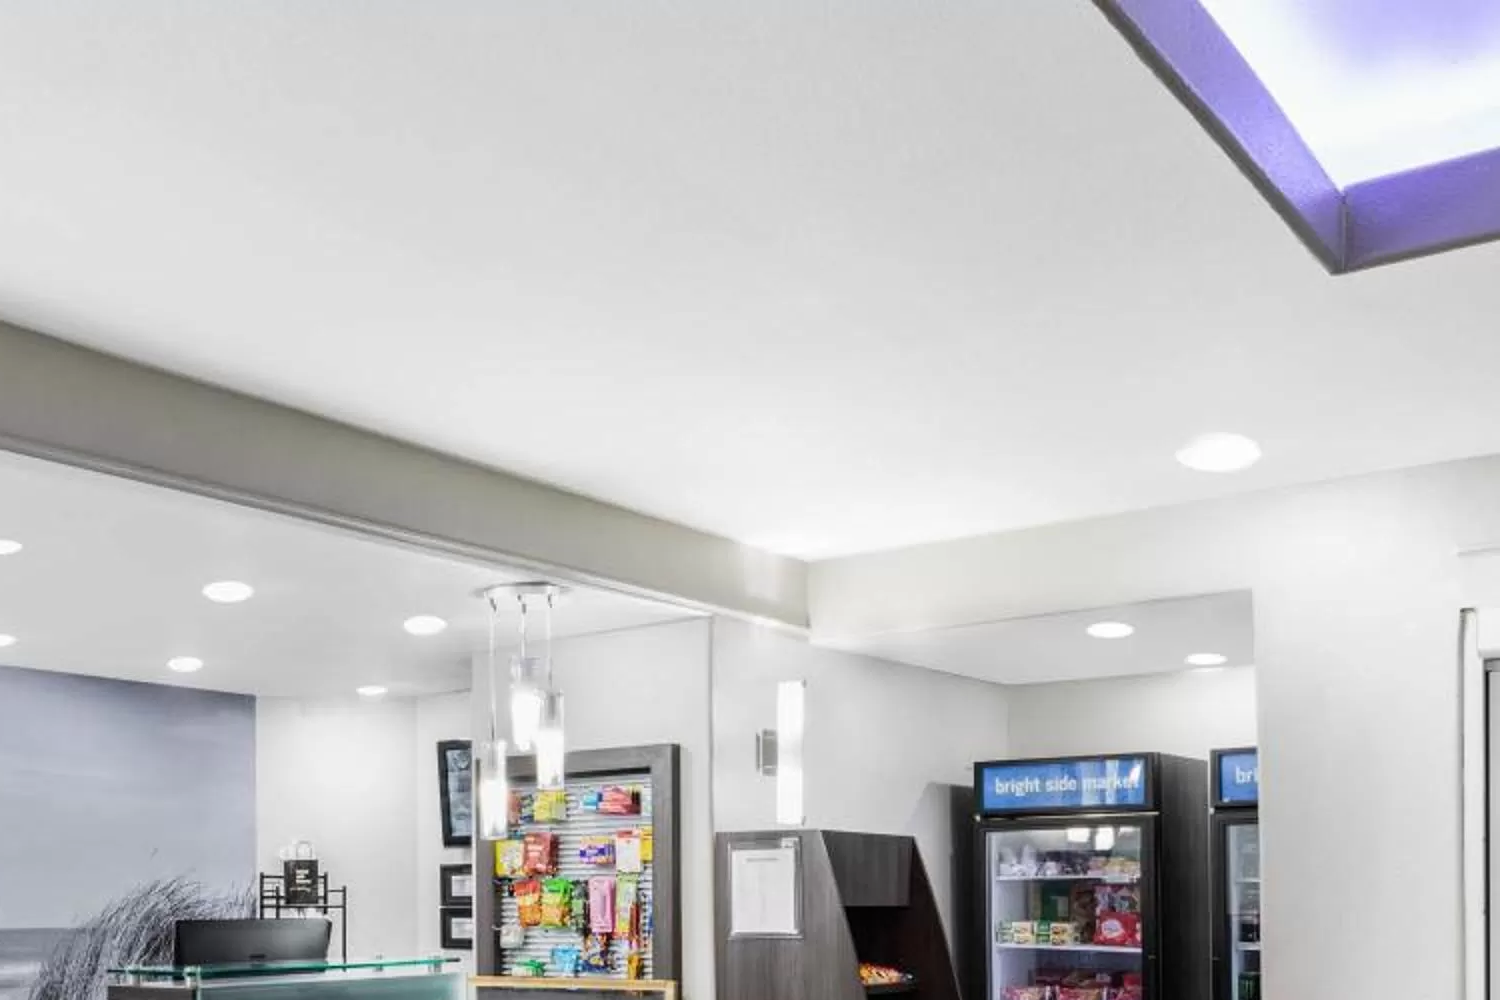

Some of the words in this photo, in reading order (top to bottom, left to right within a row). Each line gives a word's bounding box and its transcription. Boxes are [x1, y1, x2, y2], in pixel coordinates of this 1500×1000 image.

[994, 777, 1041, 797] bright
[1045, 774, 1078, 792] side
[1235, 765, 1259, 785] bri
